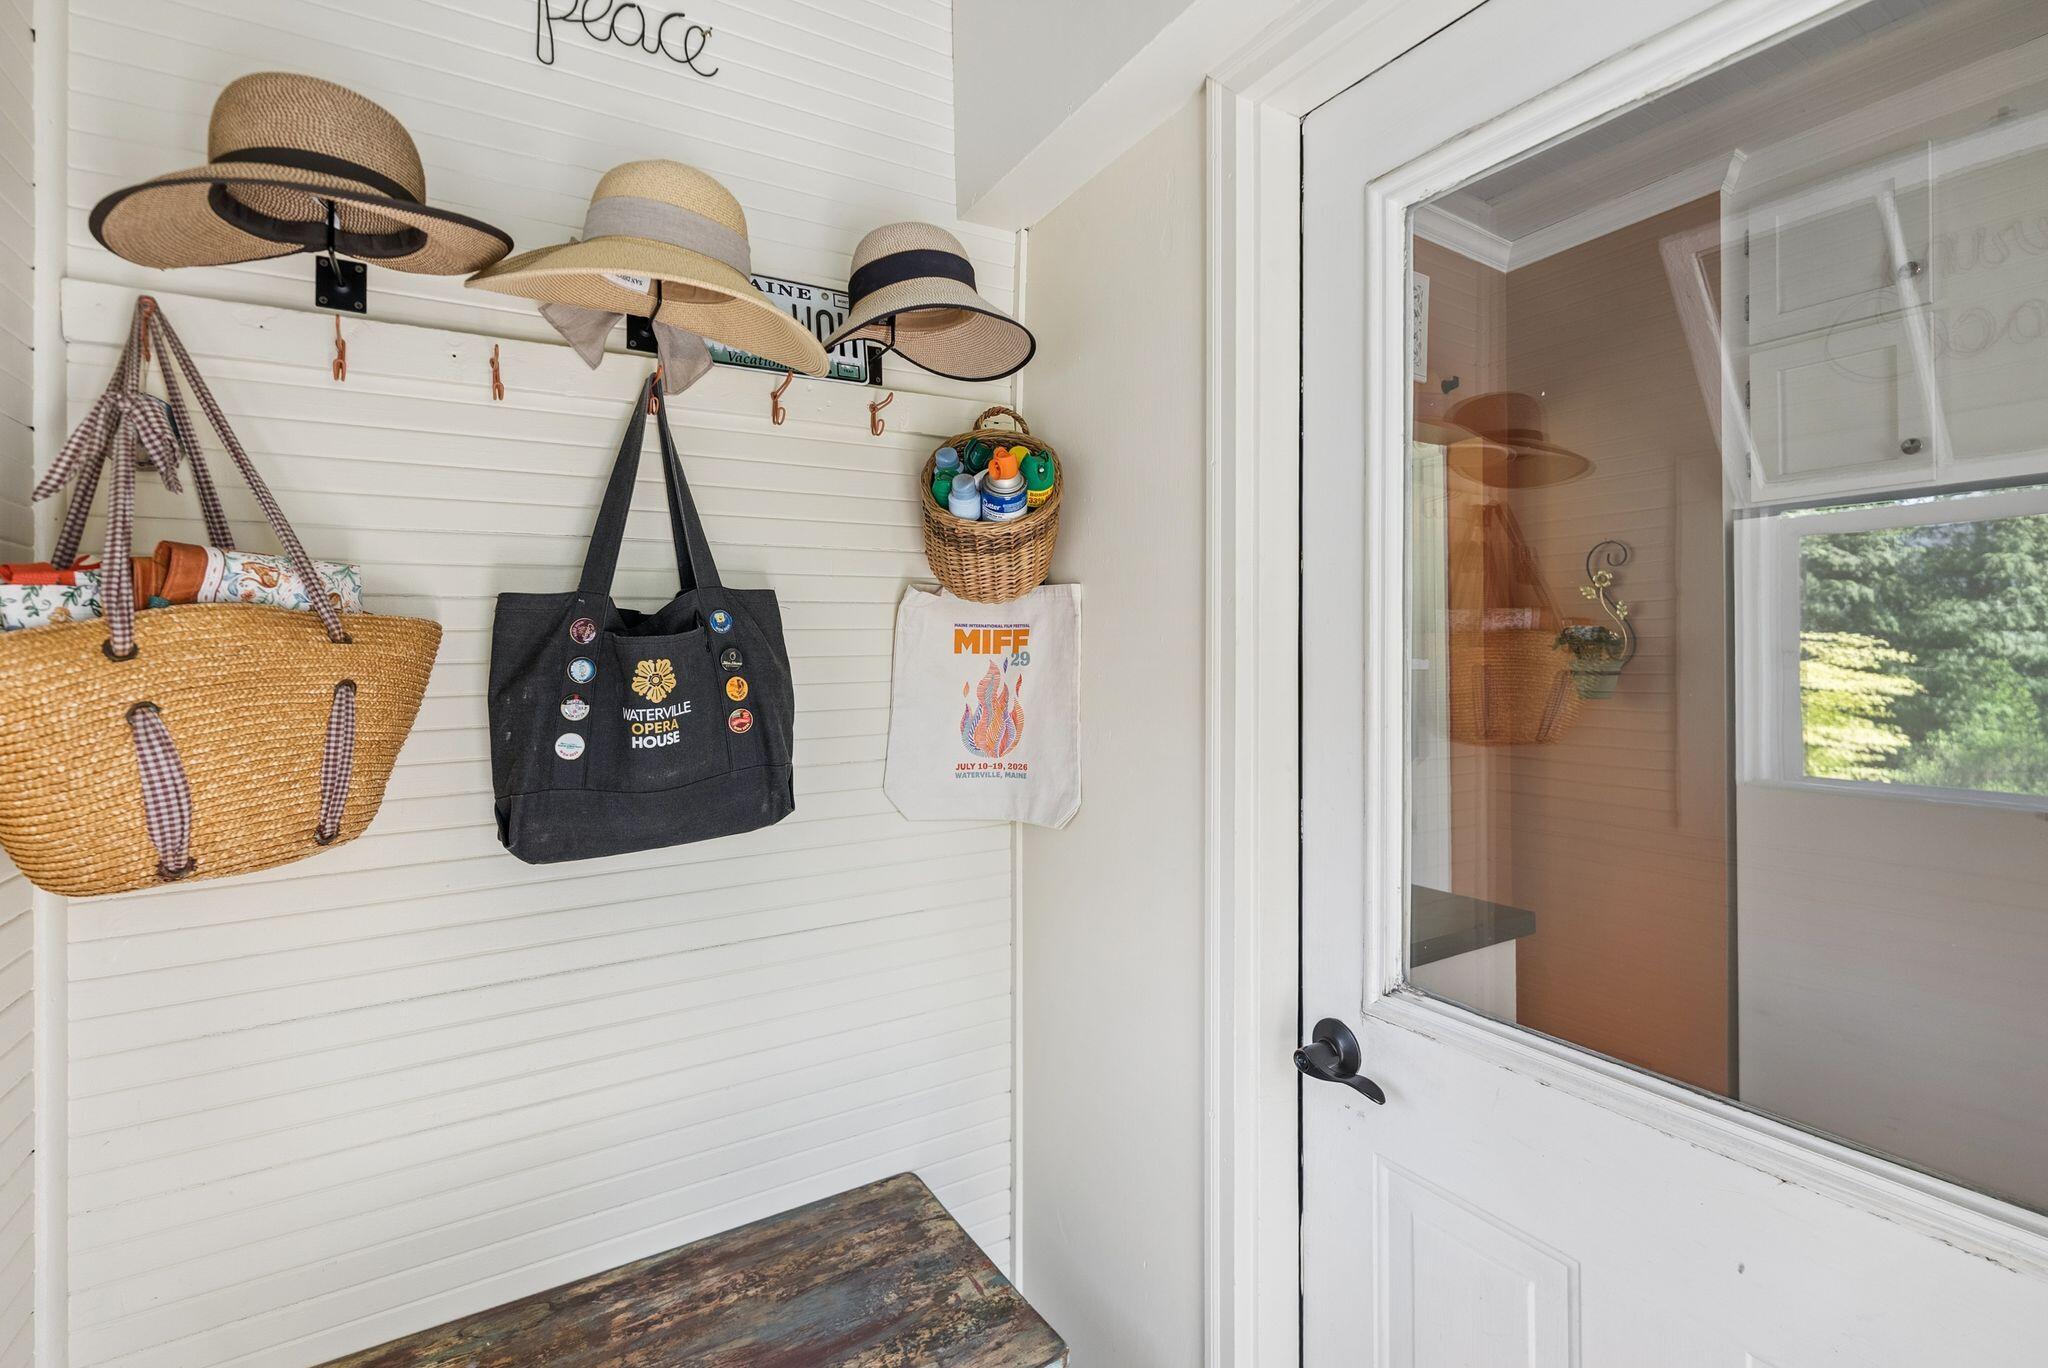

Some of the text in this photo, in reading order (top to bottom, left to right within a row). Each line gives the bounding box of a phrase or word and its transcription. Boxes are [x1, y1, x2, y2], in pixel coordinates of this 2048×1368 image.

[751, 278, 812, 301] AINE
[728, 350, 799, 371] Vacation
[983, 498, 1001, 510] Cutter
[954, 629, 1030, 654] MIFF
[1010, 651, 1031, 667] 29
[622, 700, 692, 722] WATERVILLE
[631, 718, 680, 735] OPERA
[631, 730, 681, 749] HOUSE
[954, 771, 1003, 779] WATERVILLE,
[955, 763, 976, 771] JULY
[1007, 763, 1028, 771] 2026
